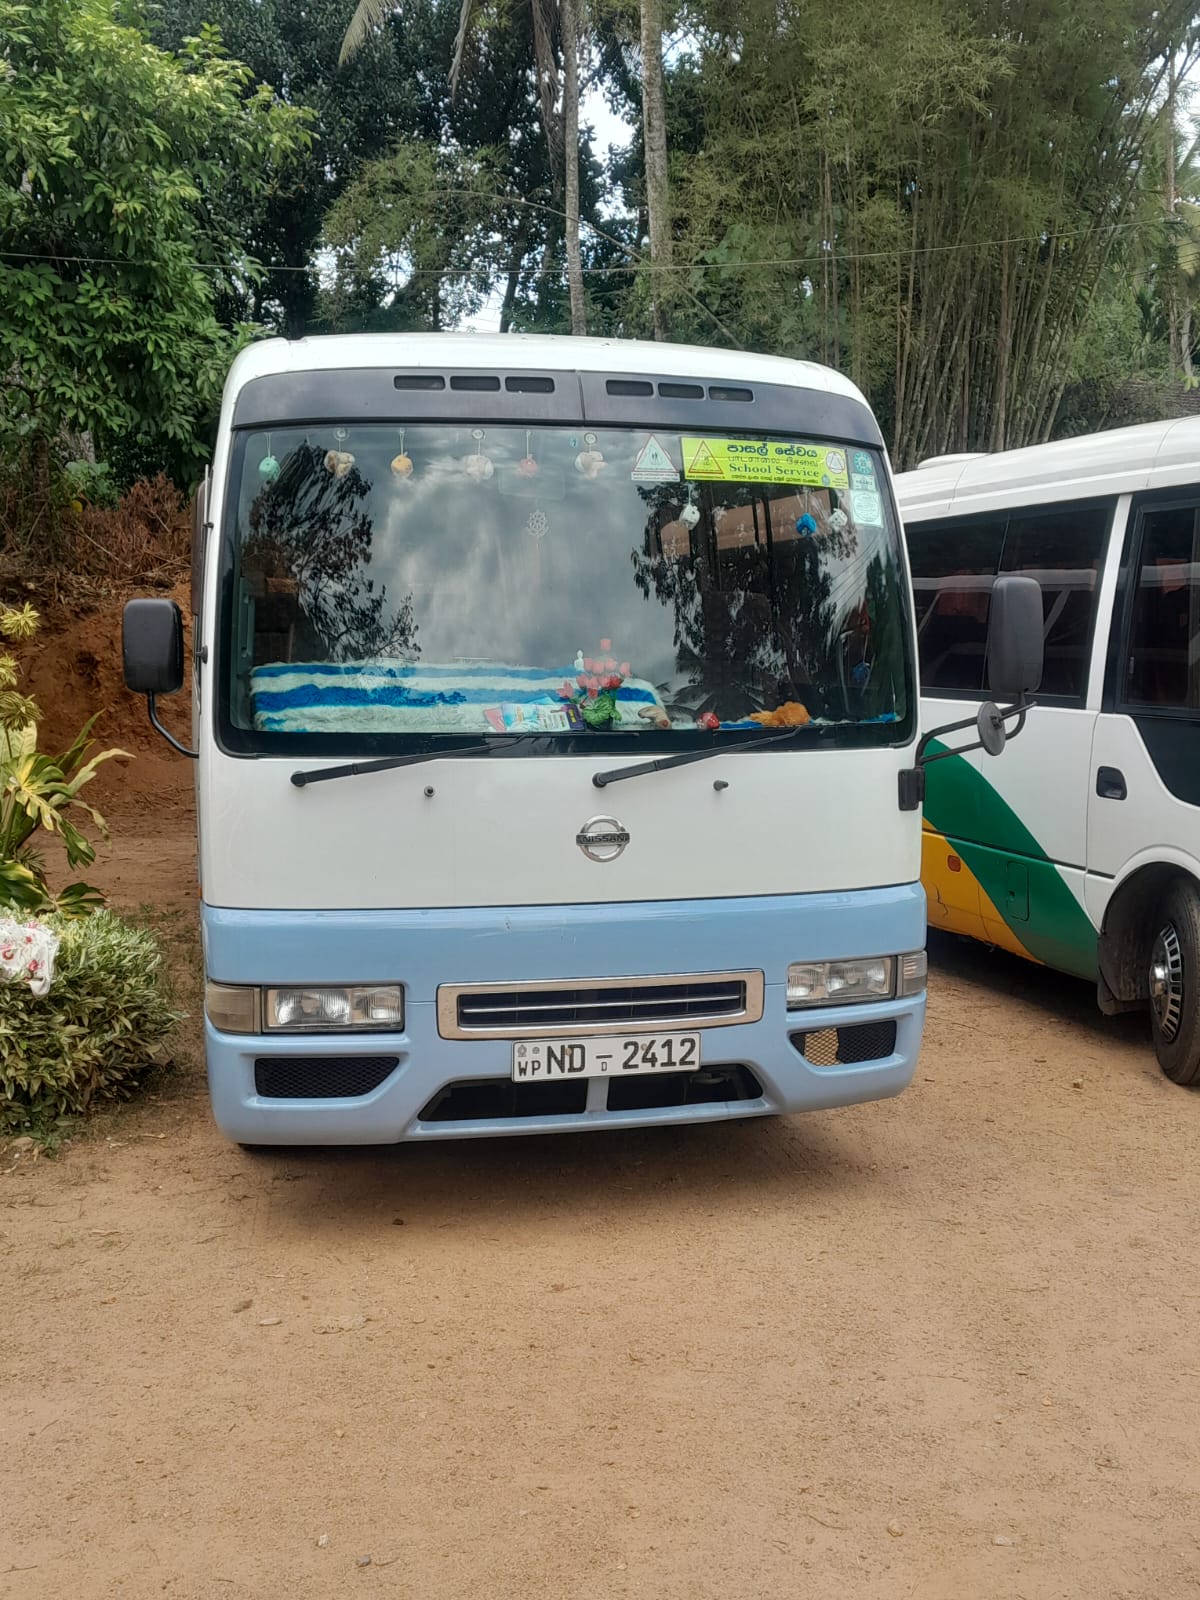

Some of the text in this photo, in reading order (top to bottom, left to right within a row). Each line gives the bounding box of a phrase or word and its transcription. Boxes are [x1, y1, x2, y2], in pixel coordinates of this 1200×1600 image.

[729, 462, 772, 474] School
[775, 465, 819, 478] Service
[580, 833, 627, 844] NISSAN
[547, 1043, 586, 1074] ND
[622, 1037, 697, 1070] 2412
[517, 1060, 542, 1077] WP
